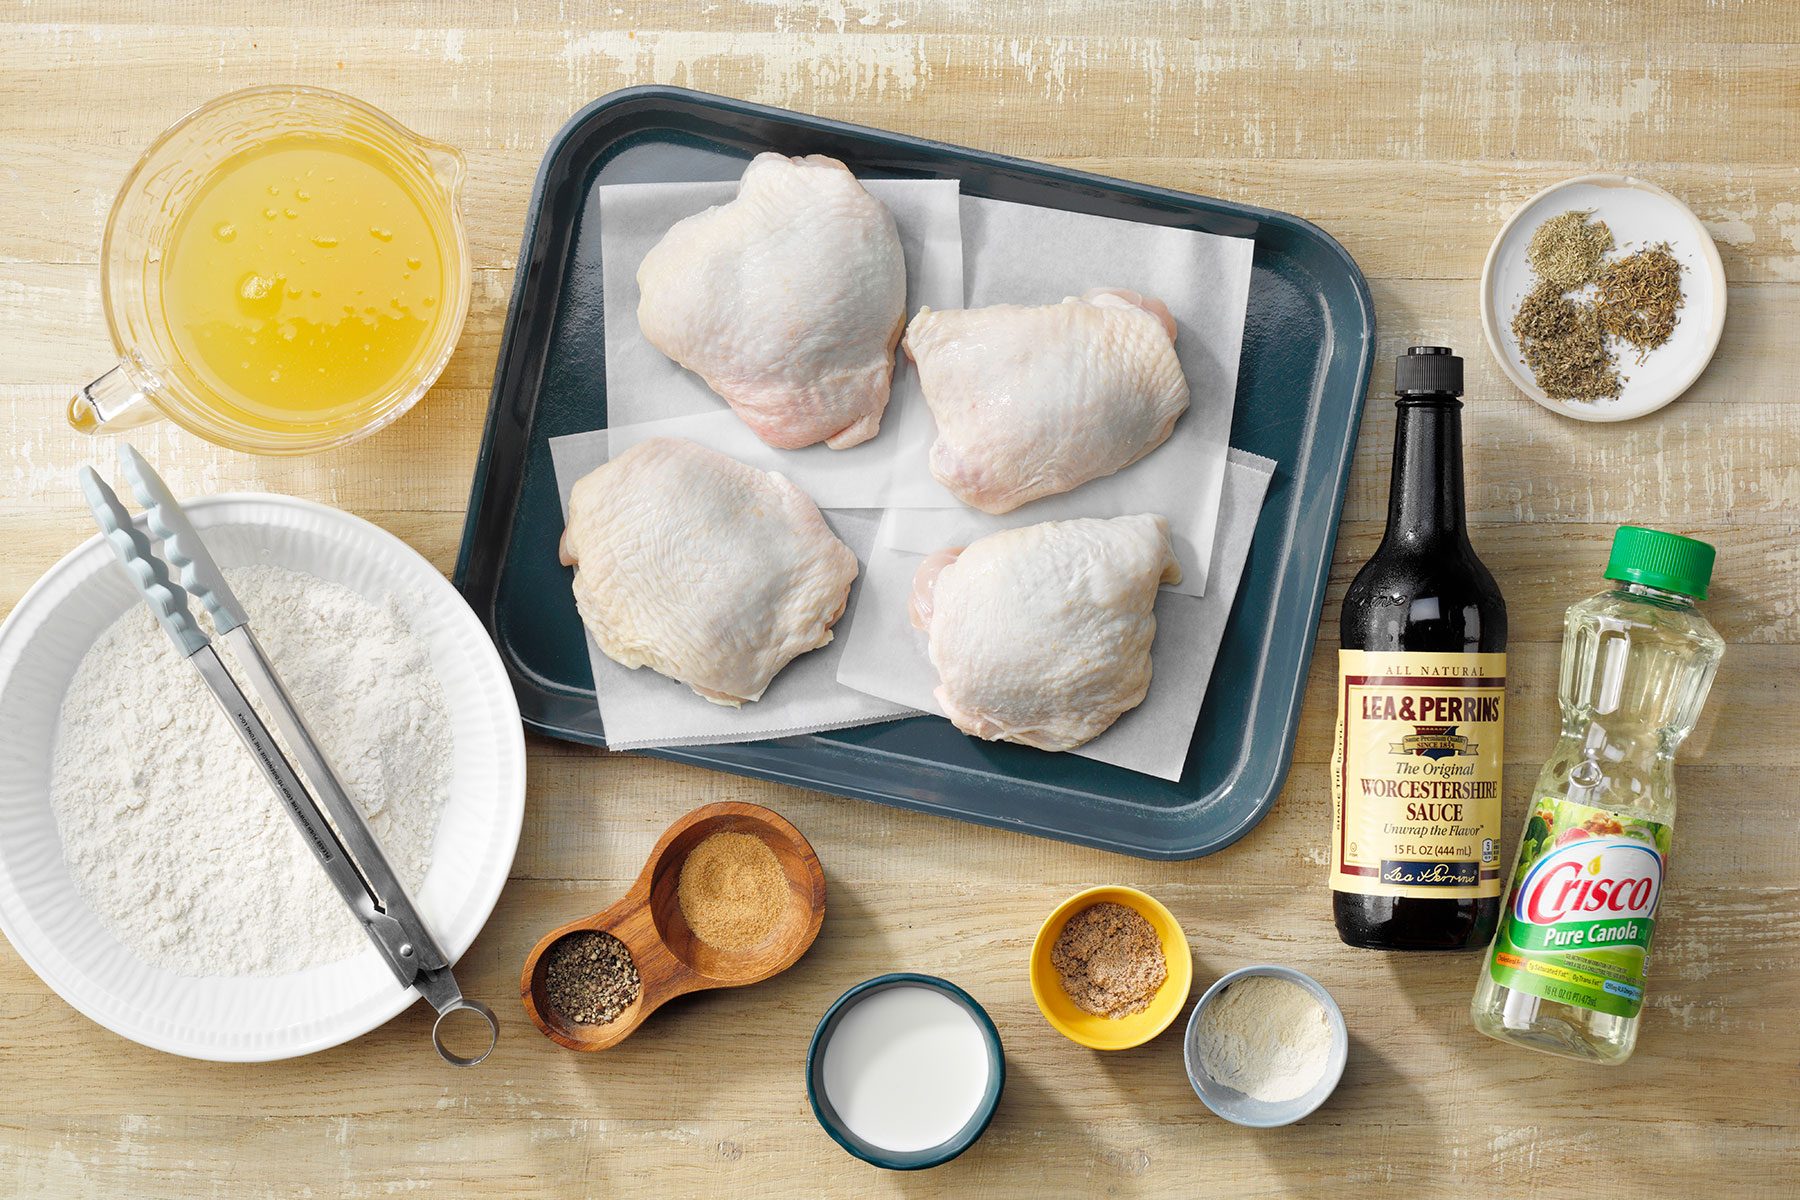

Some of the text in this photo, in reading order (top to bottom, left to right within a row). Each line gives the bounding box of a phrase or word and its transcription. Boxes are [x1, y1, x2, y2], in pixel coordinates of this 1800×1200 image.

[1386, 666, 1485, 676] ALL NATURAL
[1396, 761, 1474, 779] The Original
[1360, 778, 1497, 799] WORCESTERSHIRE
[1406, 802, 1463, 822] SAUCE
[1383, 823, 1428, 838] Unwrap
[1430, 824, 1448, 836] the
[1394, 845, 1404, 855] 15
[1406, 845, 1417, 855] FL
[1419, 845, 1433, 856] OZ
[1434, 845, 1455, 857] (444
[1456, 845, 1472, 857] mL)
[1543, 927, 1583, 947] Pure
[1588, 921, 1638, 943] Canola
